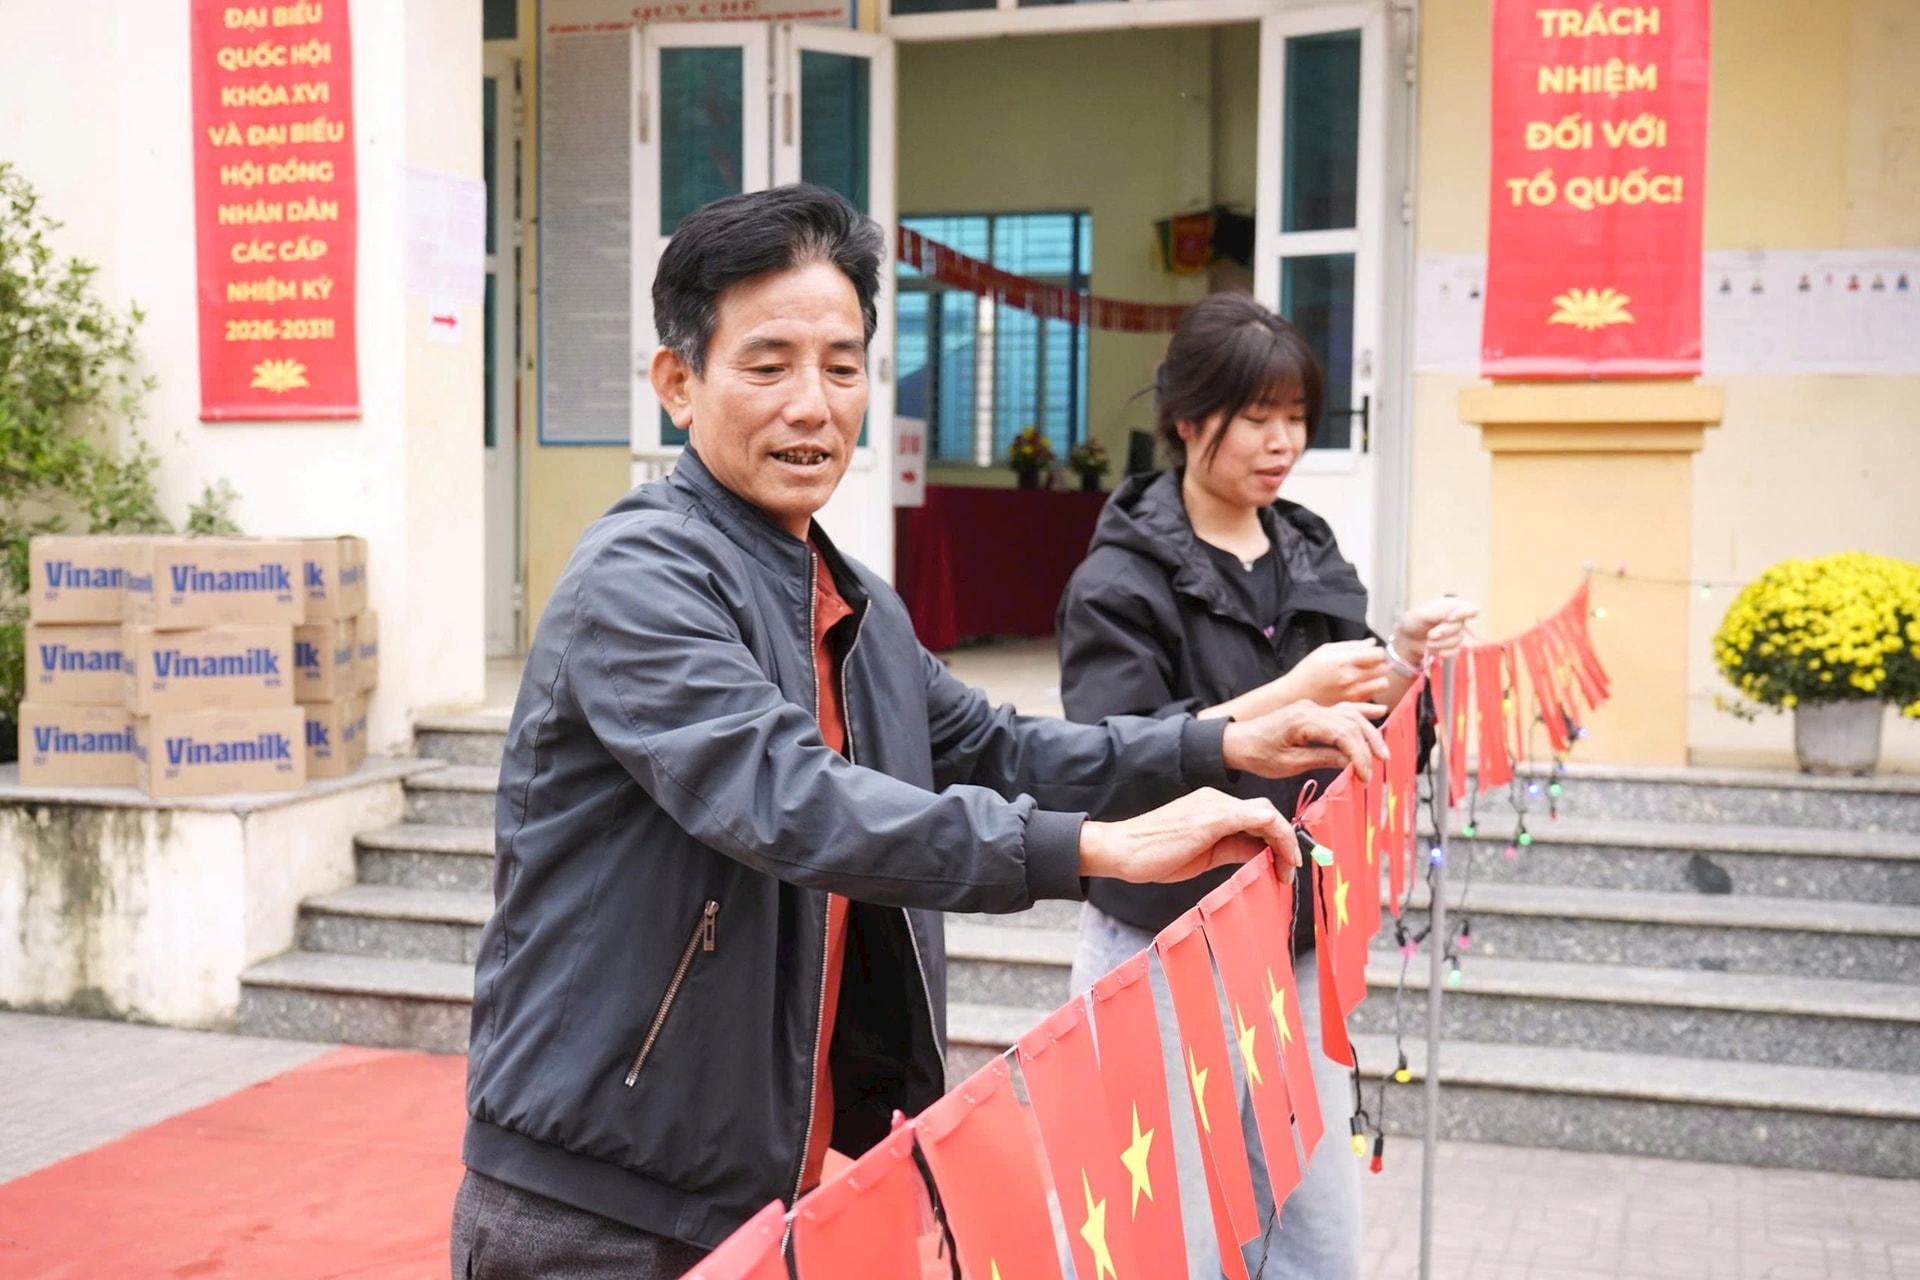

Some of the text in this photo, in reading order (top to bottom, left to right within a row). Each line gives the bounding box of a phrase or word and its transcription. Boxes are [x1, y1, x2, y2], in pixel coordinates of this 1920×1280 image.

[224, 6, 267, 32] ĐẠI
[1536, 2, 1660, 37] TRÁCH
[217, 37, 332, 71] QUỐC HỘI
[1537, 57, 1658, 99] NHIỆM
[221, 80, 330, 107] KHÓA XVI
[208, 120, 243, 147] VÀ
[247, 124, 287, 150] ĐẠI
[1524, 112, 1667, 150] ĐỐI VỚI
[220, 160, 264, 189] HỘI
[1564, 166, 1684, 210] QUỐC!
[218, 196, 338, 224] NHÂN DÂN
[231, 234, 328, 263] CÁC CẤP
[227, 276, 296, 305] NHIỆM
[225, 318, 335, 341] 2026-2031!
[170, 564, 291, 592] Vinamilk
[152, 648, 279, 678] Vinamilk
[33, 725, 132, 753] Vinami
[165, 733, 290, 764] Vinamilk
